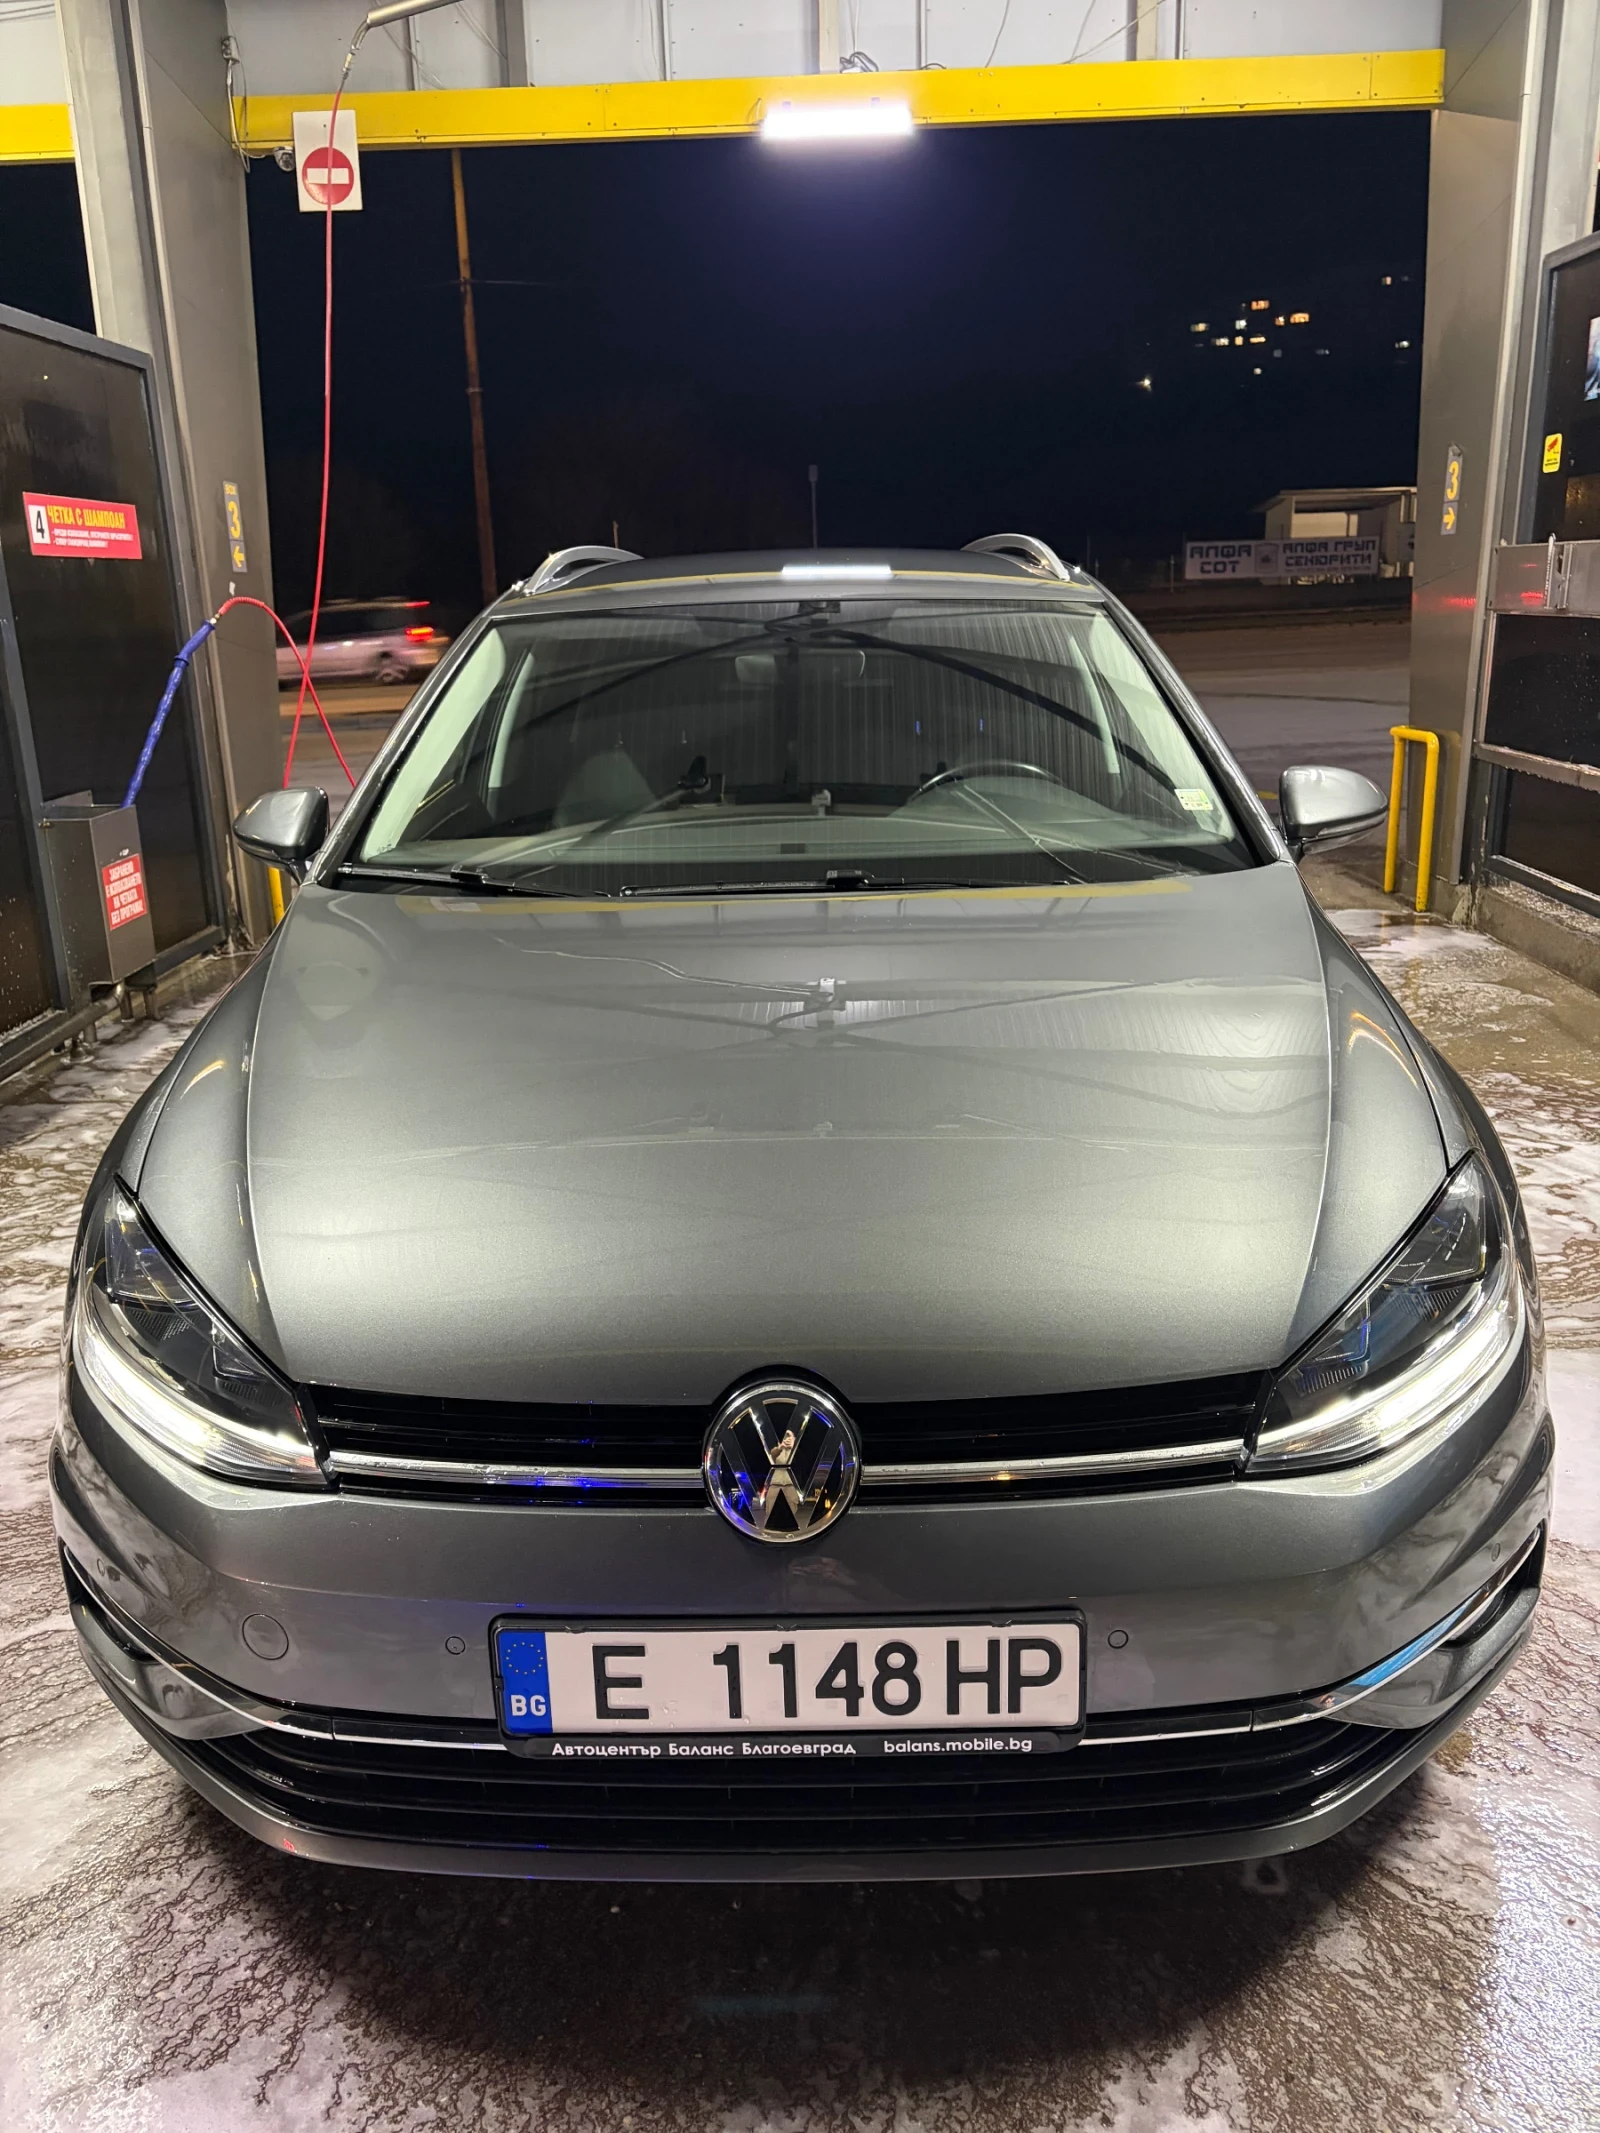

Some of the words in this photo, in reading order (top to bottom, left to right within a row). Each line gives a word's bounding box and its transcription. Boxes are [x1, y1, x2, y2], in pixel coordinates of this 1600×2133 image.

[1446, 460, 1459, 500] 3
[36, 510, 45, 539] 4
[47, 504, 75, 526] ЧЕТКА
[75, 507, 83, 526] С
[83, 508, 126, 530] ШАМПОАН
[228, 500, 241, 539] 3
[1200, 560, 1240, 574] СОТ
[713, 1640, 921, 1719] 1148
[511, 1694, 547, 1717] BG
[552, 1742, 662, 1759] Автоцентър
[668, 1742, 733, 1757] Баланс
[742, 1741, 856, 1758] Благоевград
[883, 1736, 1033, 1755] balans.mobile.bg
